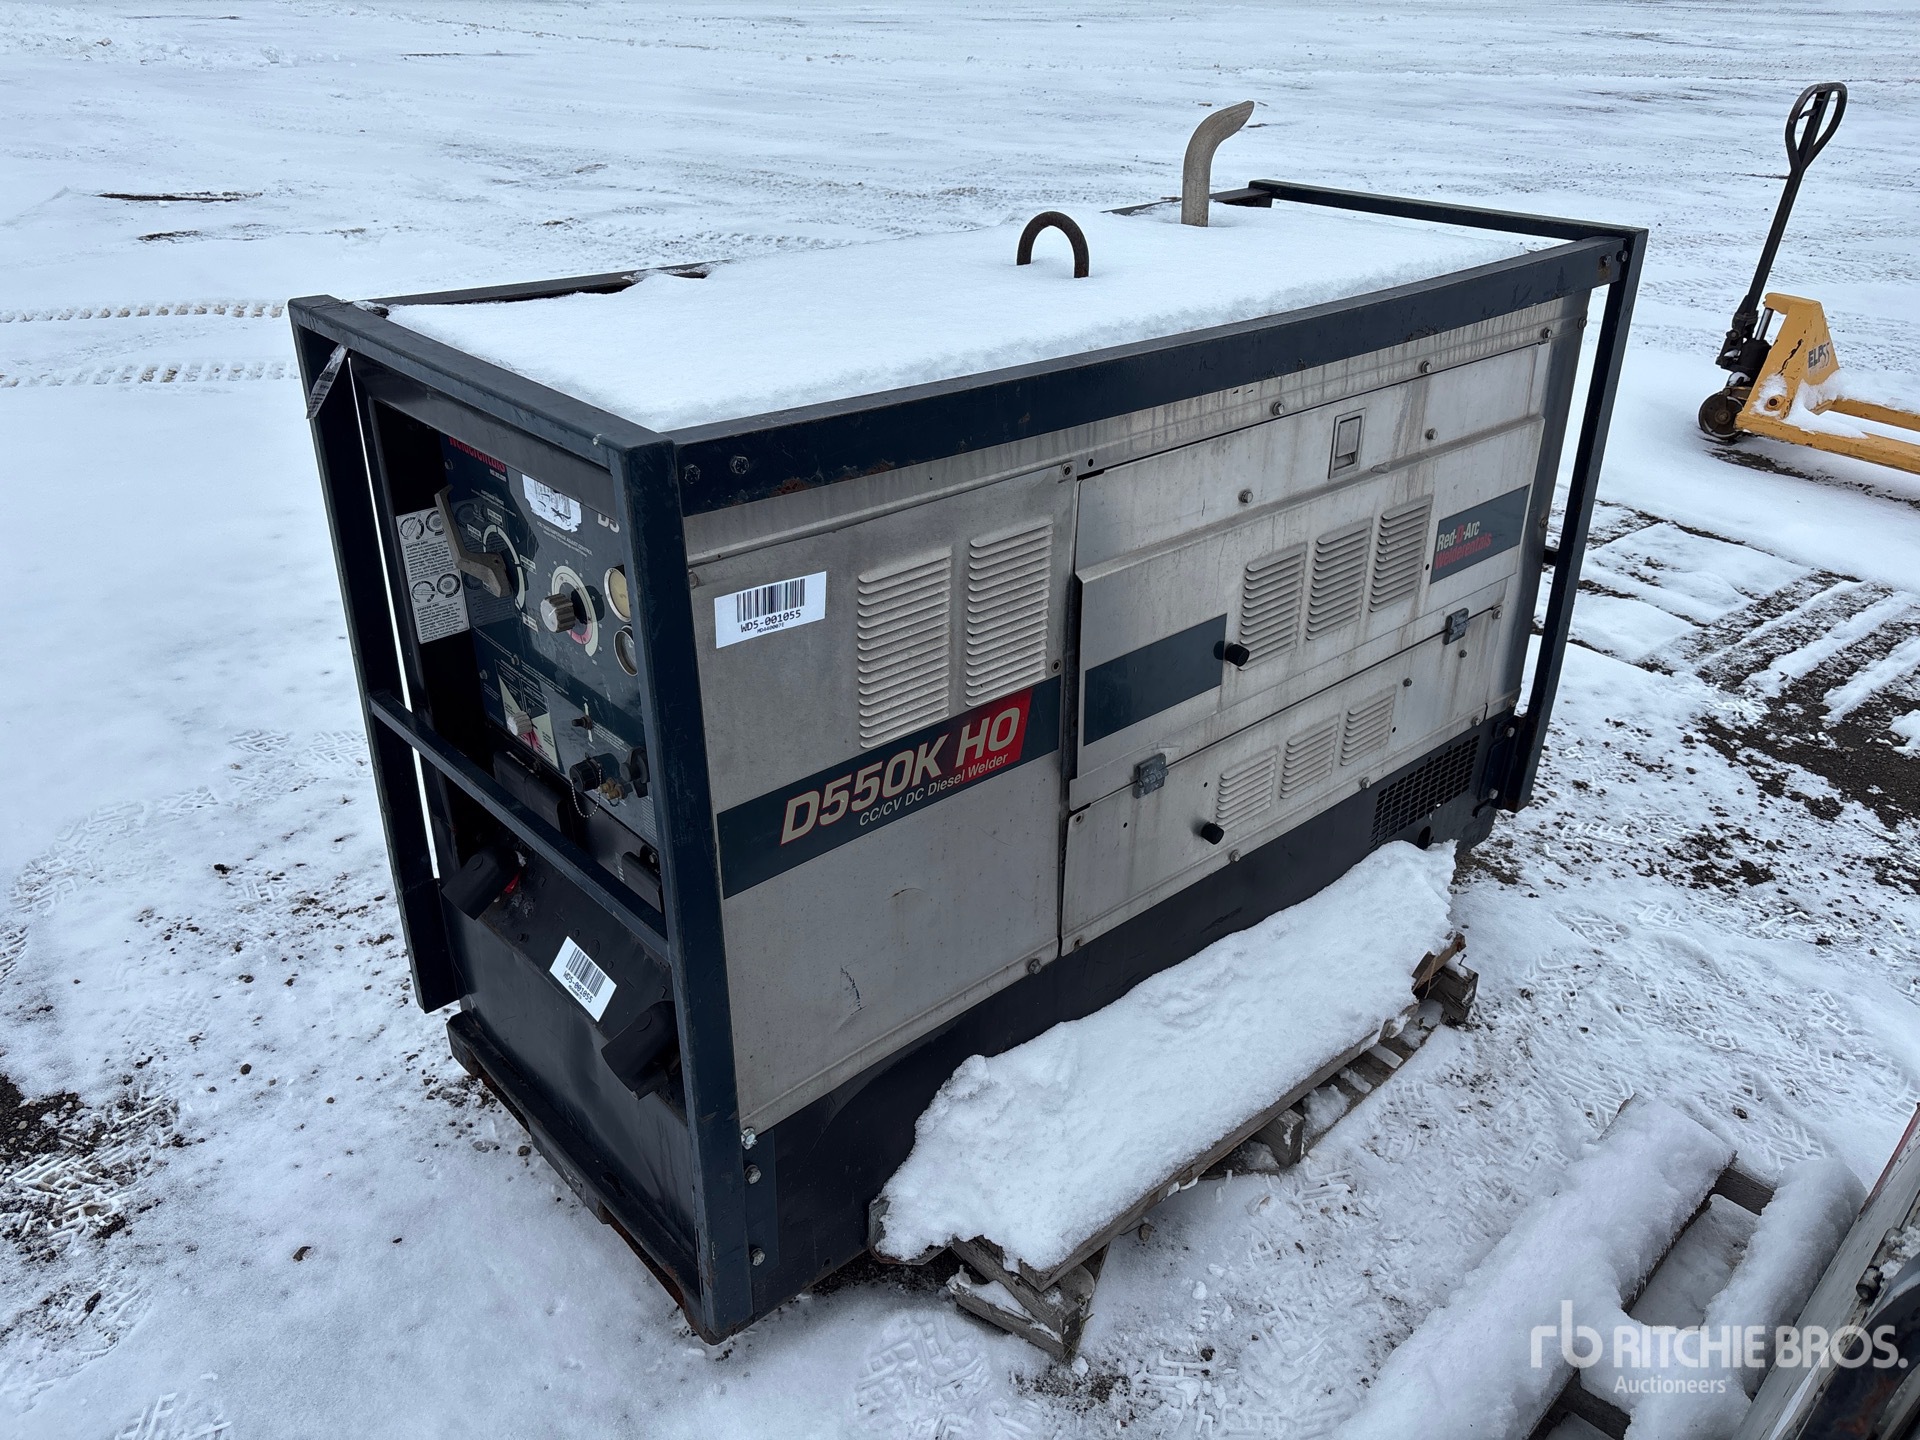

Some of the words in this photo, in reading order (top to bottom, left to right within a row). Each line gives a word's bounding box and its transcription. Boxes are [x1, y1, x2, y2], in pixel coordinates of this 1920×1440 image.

[740, 609, 802, 633] WD5-001055
[780, 733, 949, 846] D550K
[955, 706, 1021, 768] HO
[859, 797, 903, 827] CC/CV
[904, 787, 924, 807] DC
[927, 768, 965, 795] Diesel
[967, 751, 1009, 779] Welder
